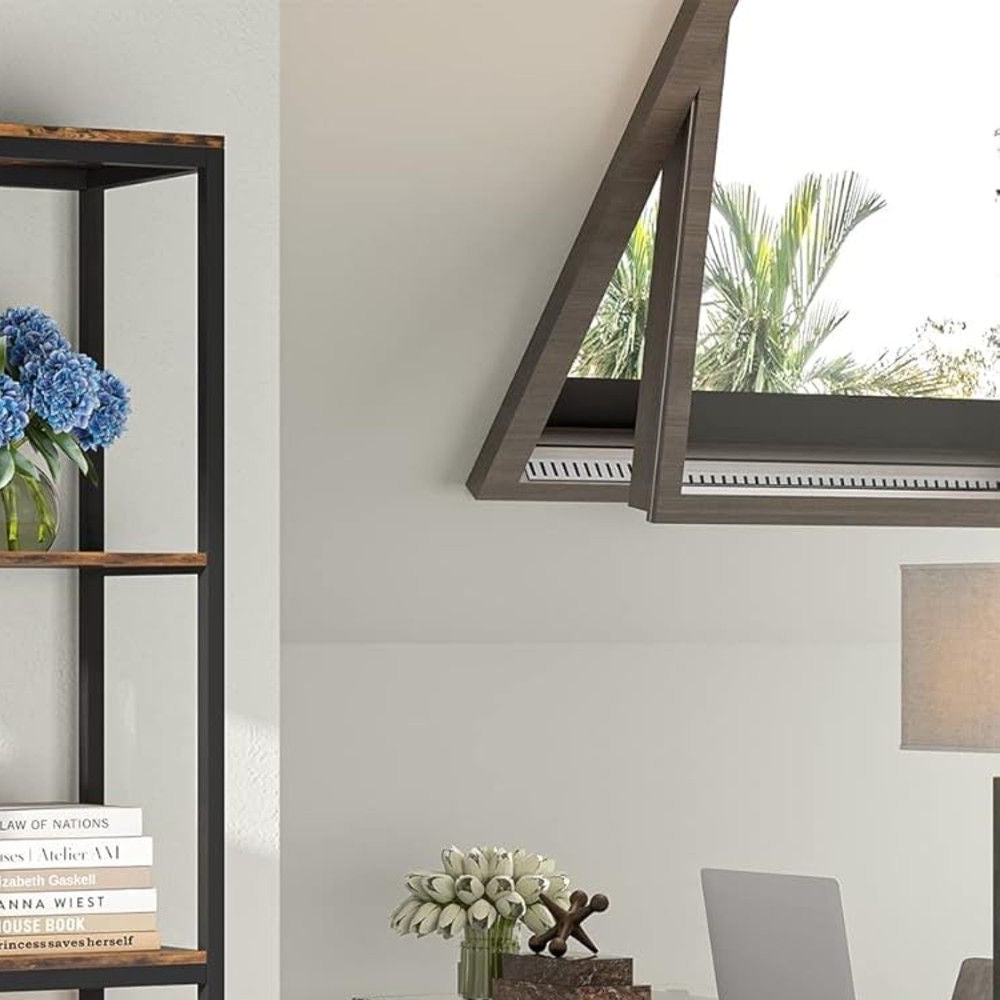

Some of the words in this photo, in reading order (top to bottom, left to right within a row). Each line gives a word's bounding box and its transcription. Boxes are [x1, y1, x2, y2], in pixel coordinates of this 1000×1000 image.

[0, 819, 27, 831] LAW
[30, 818, 47, 830] OF
[52, 817, 109, 830] NATIONS
[38, 846, 87, 862] Atelier
[48, 874, 96, 887] Gaskell
[54, 896, 105, 909] WIEST
[45, 917, 86, 932] BOOK
